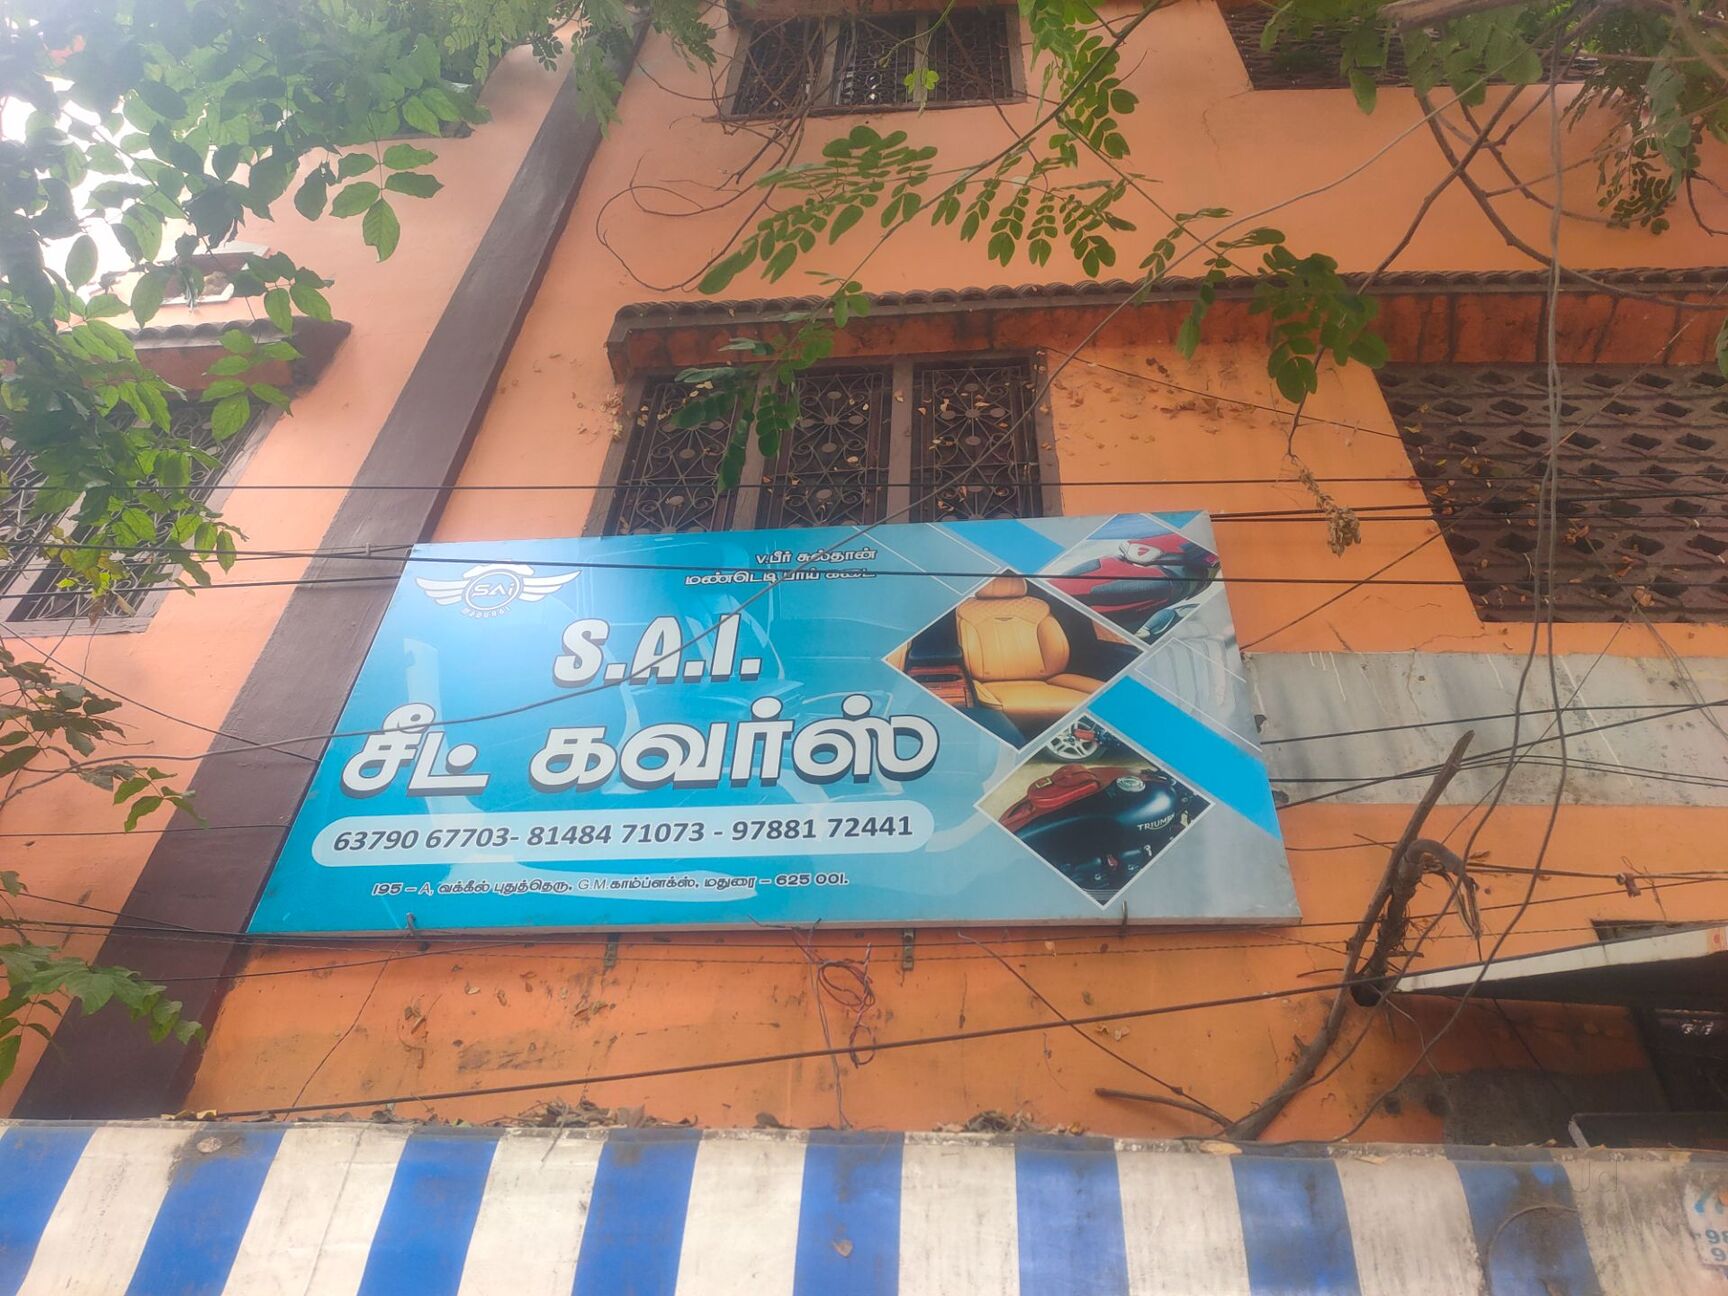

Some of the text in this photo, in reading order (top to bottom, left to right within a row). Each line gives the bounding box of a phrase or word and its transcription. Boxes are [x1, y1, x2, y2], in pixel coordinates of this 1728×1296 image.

[552, 613, 763, 688] S.A.I.
[340, 693, 941, 798] சீட் கவர்ஸ்
[333, 829, 419, 852] 63790
[526, 823, 612, 847] 81484
[621, 821, 706, 844] 71073
[731, 818, 818, 842] 97881
[827, 814, 914, 839] 72441
[438, 879, 490, 895] வக்கீல்
[703, 875, 757, 891] மதுரை
[775, 872, 813, 887] 625
